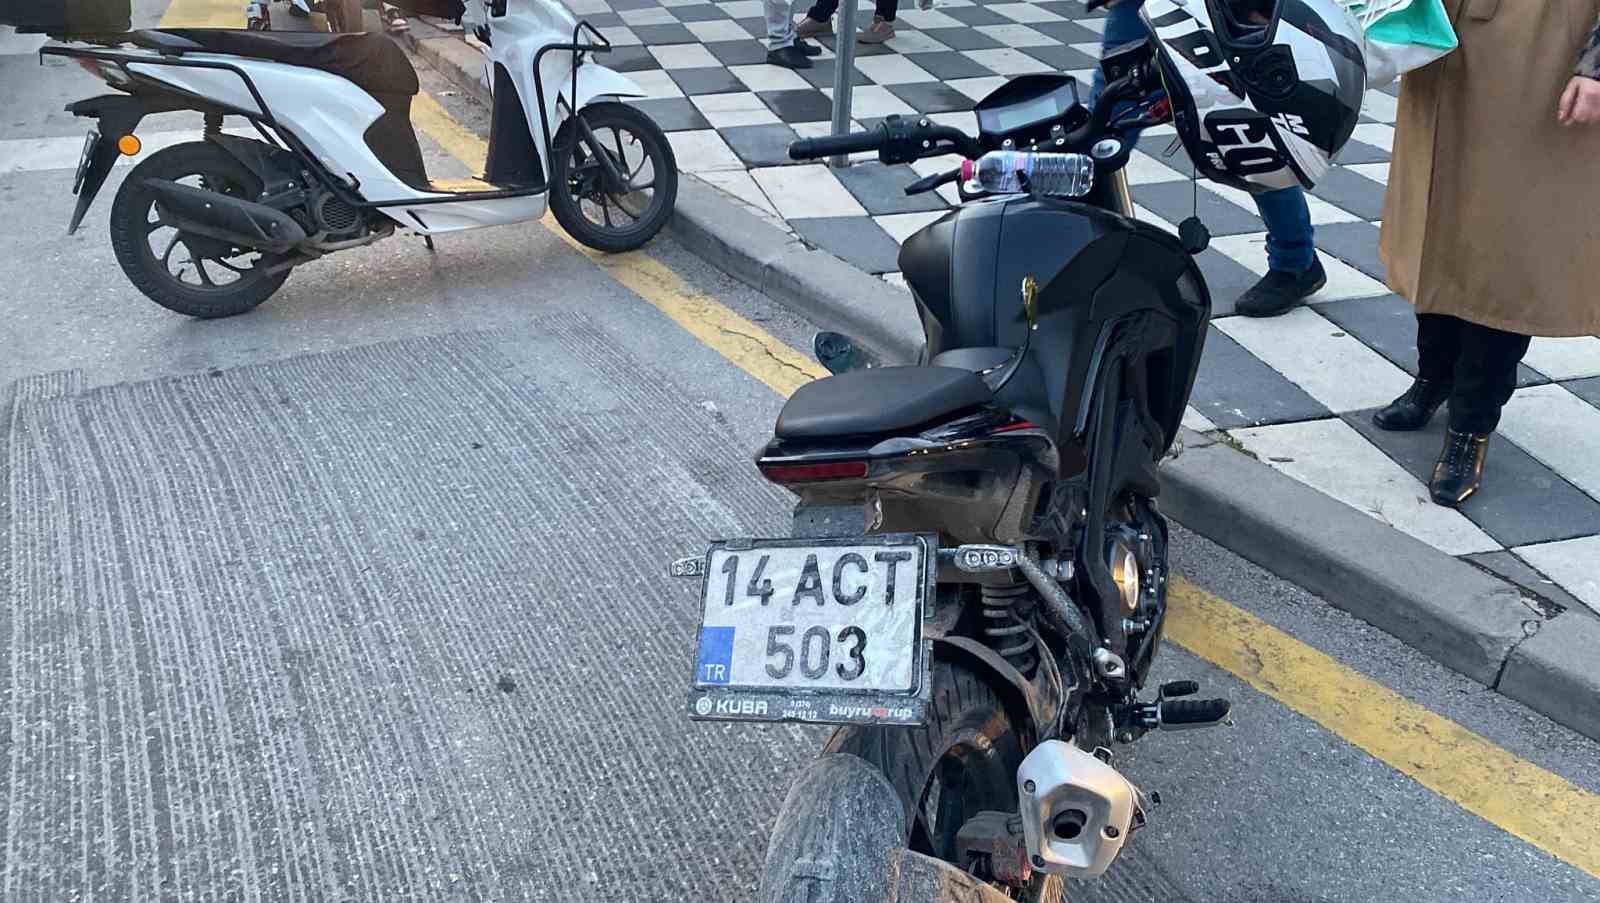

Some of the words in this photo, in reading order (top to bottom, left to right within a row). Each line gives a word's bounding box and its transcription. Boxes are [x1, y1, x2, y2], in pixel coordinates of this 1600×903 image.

[721, 554, 775, 607] 14
[791, 551, 913, 607] ACT
[704, 663, 726, 681] TR
[764, 625, 868, 682] 503
[716, 699, 769, 715] KUBA
